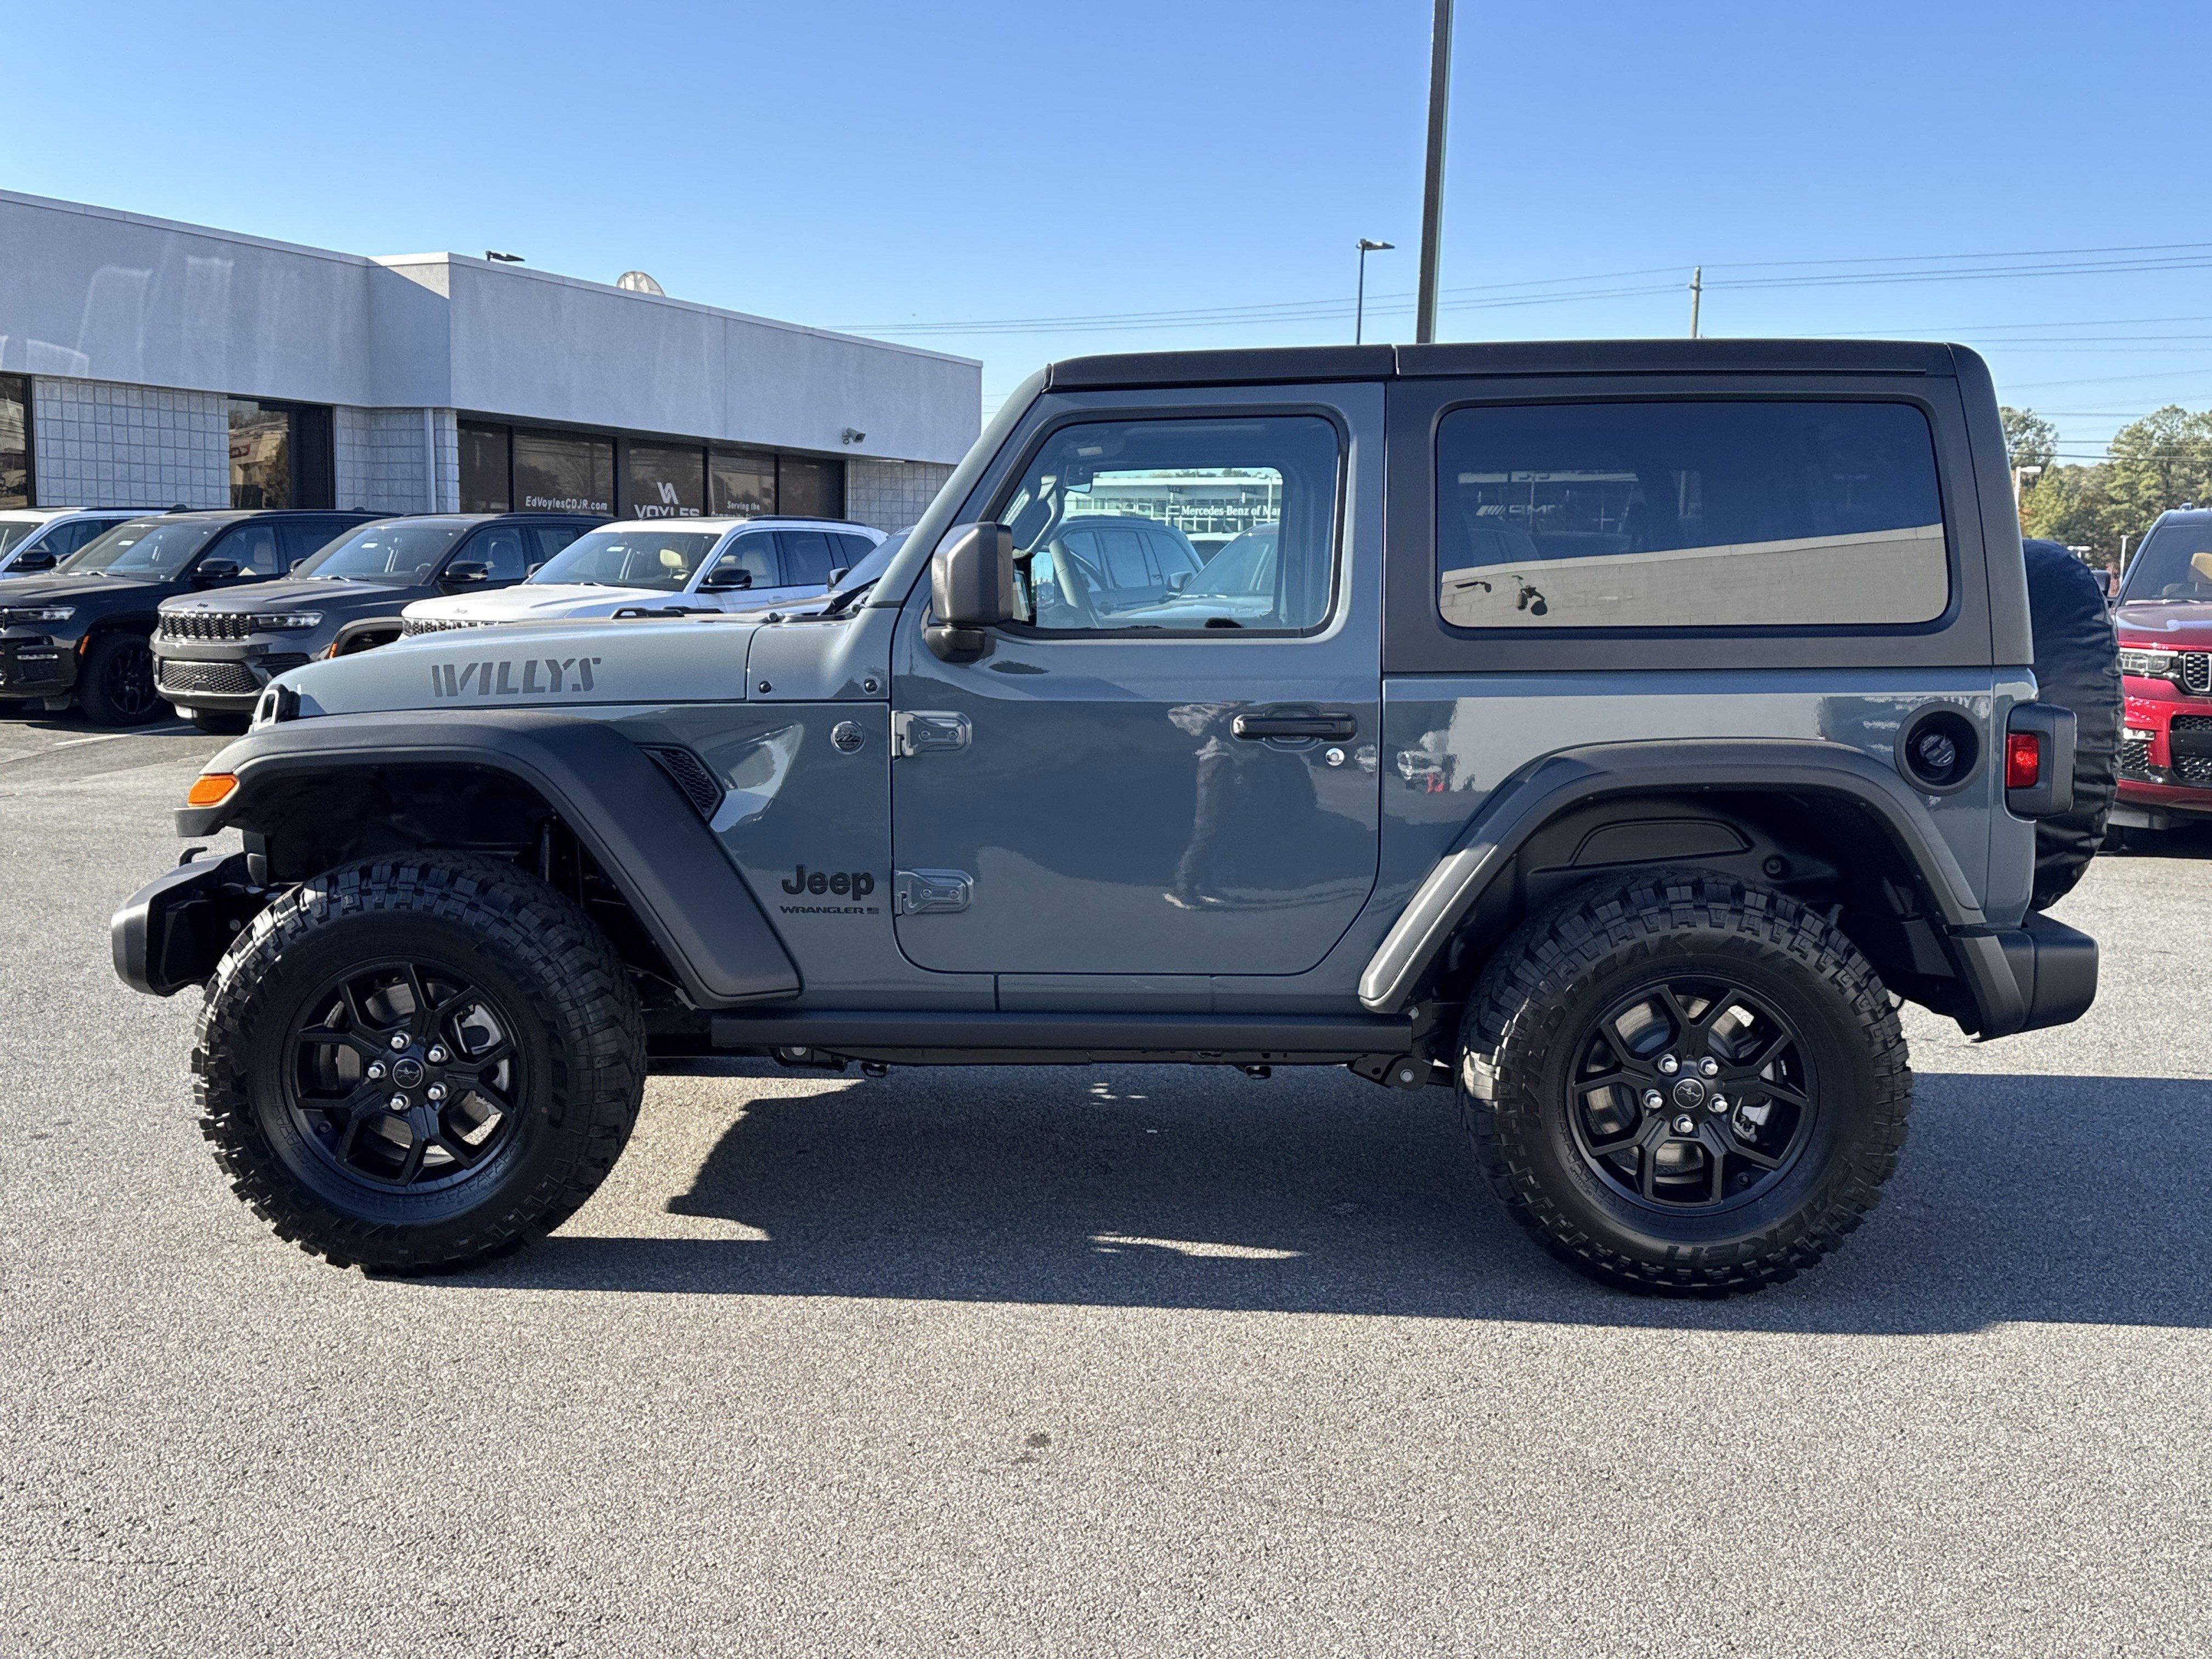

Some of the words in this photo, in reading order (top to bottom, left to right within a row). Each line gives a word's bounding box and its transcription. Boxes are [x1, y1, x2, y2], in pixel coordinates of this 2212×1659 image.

[525, 495, 607, 510] EdVoylesCDJR.com
[727, 500, 749, 512] Serving
[1181, 505, 1249, 516] Mercedes-Benz
[1251, 505, 1261, 516] of
[431, 657, 602, 698] WILLYS
[781, 864, 875, 901] Jeep
[779, 906, 865, 915] WRANGLER
